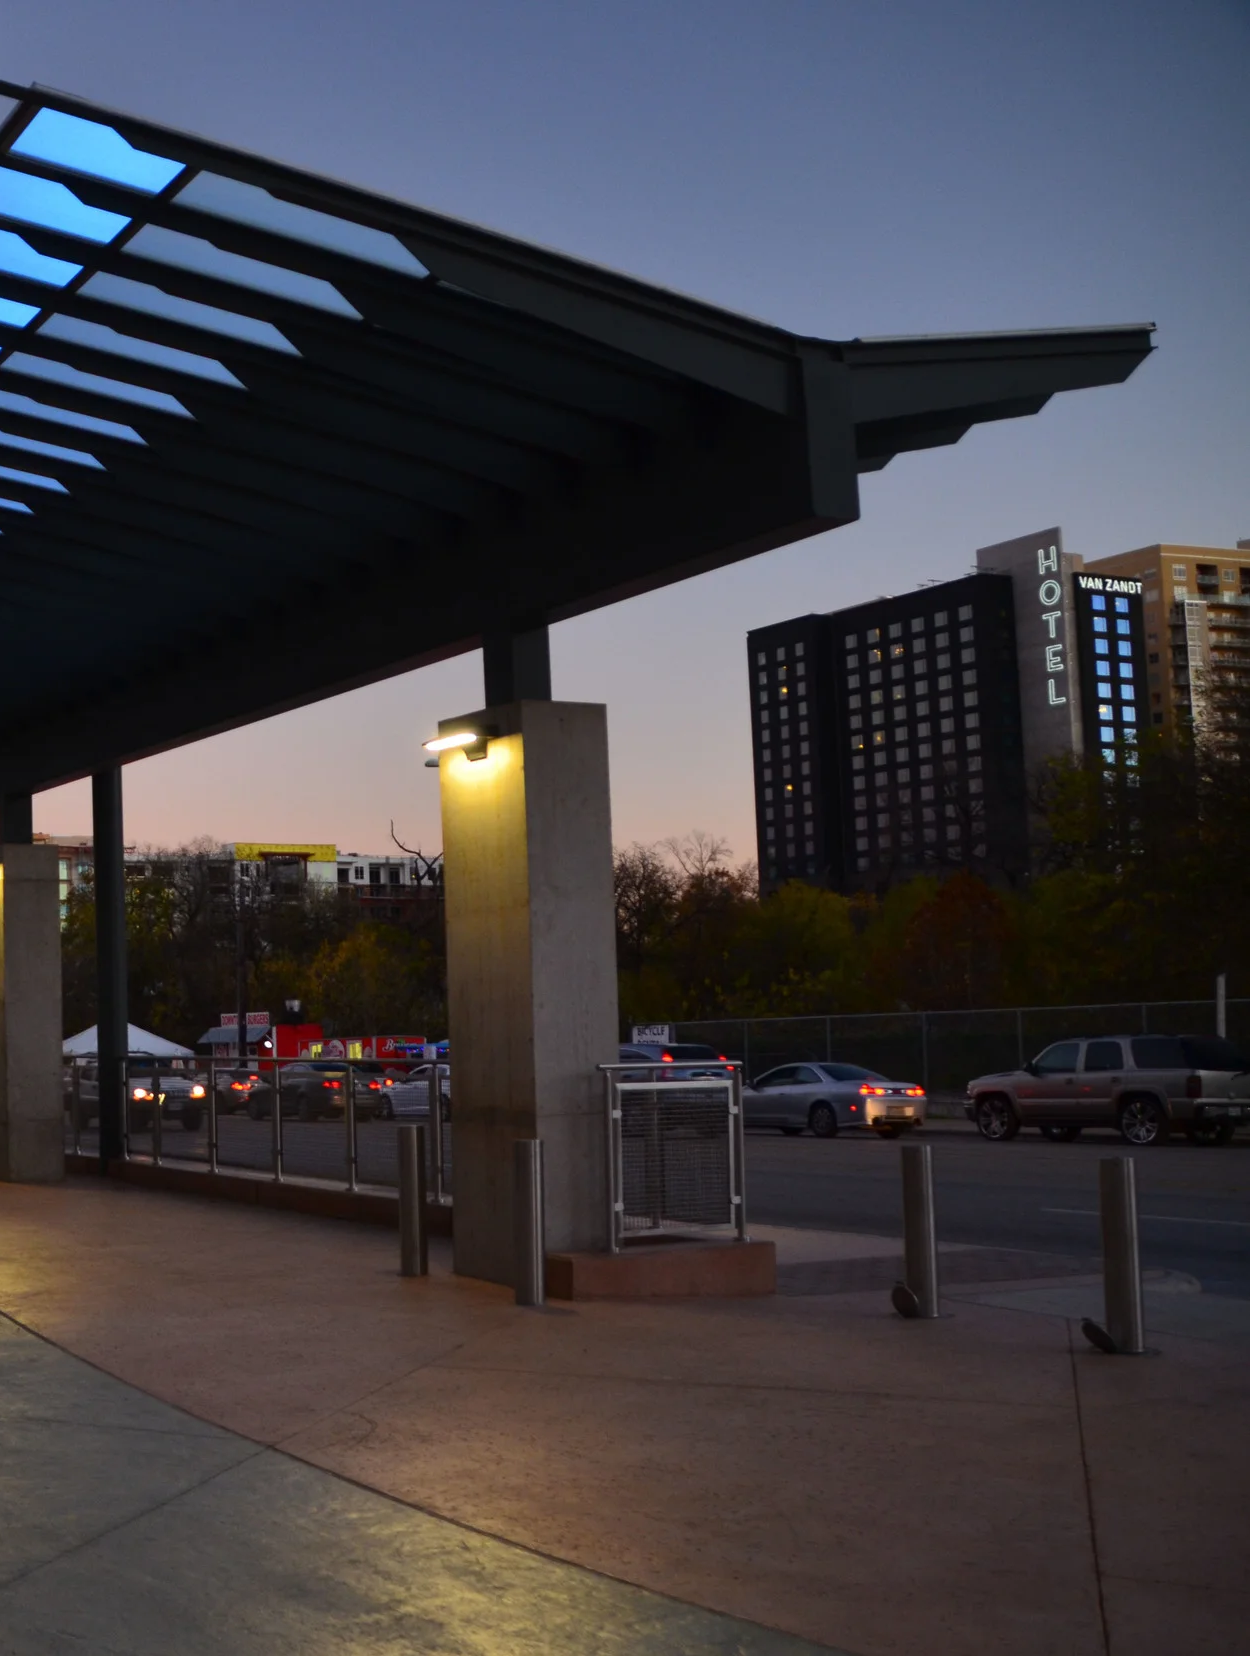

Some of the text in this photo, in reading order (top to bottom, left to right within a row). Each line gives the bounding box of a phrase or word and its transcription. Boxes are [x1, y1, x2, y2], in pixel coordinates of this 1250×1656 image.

[1079, 575, 1143, 594] VAN ZANDT
[1037, 545, 1066, 705] HOTEL
[247, 1013, 269, 1025] BURGERS
[637, 1026, 665, 1036] BICYCLE
